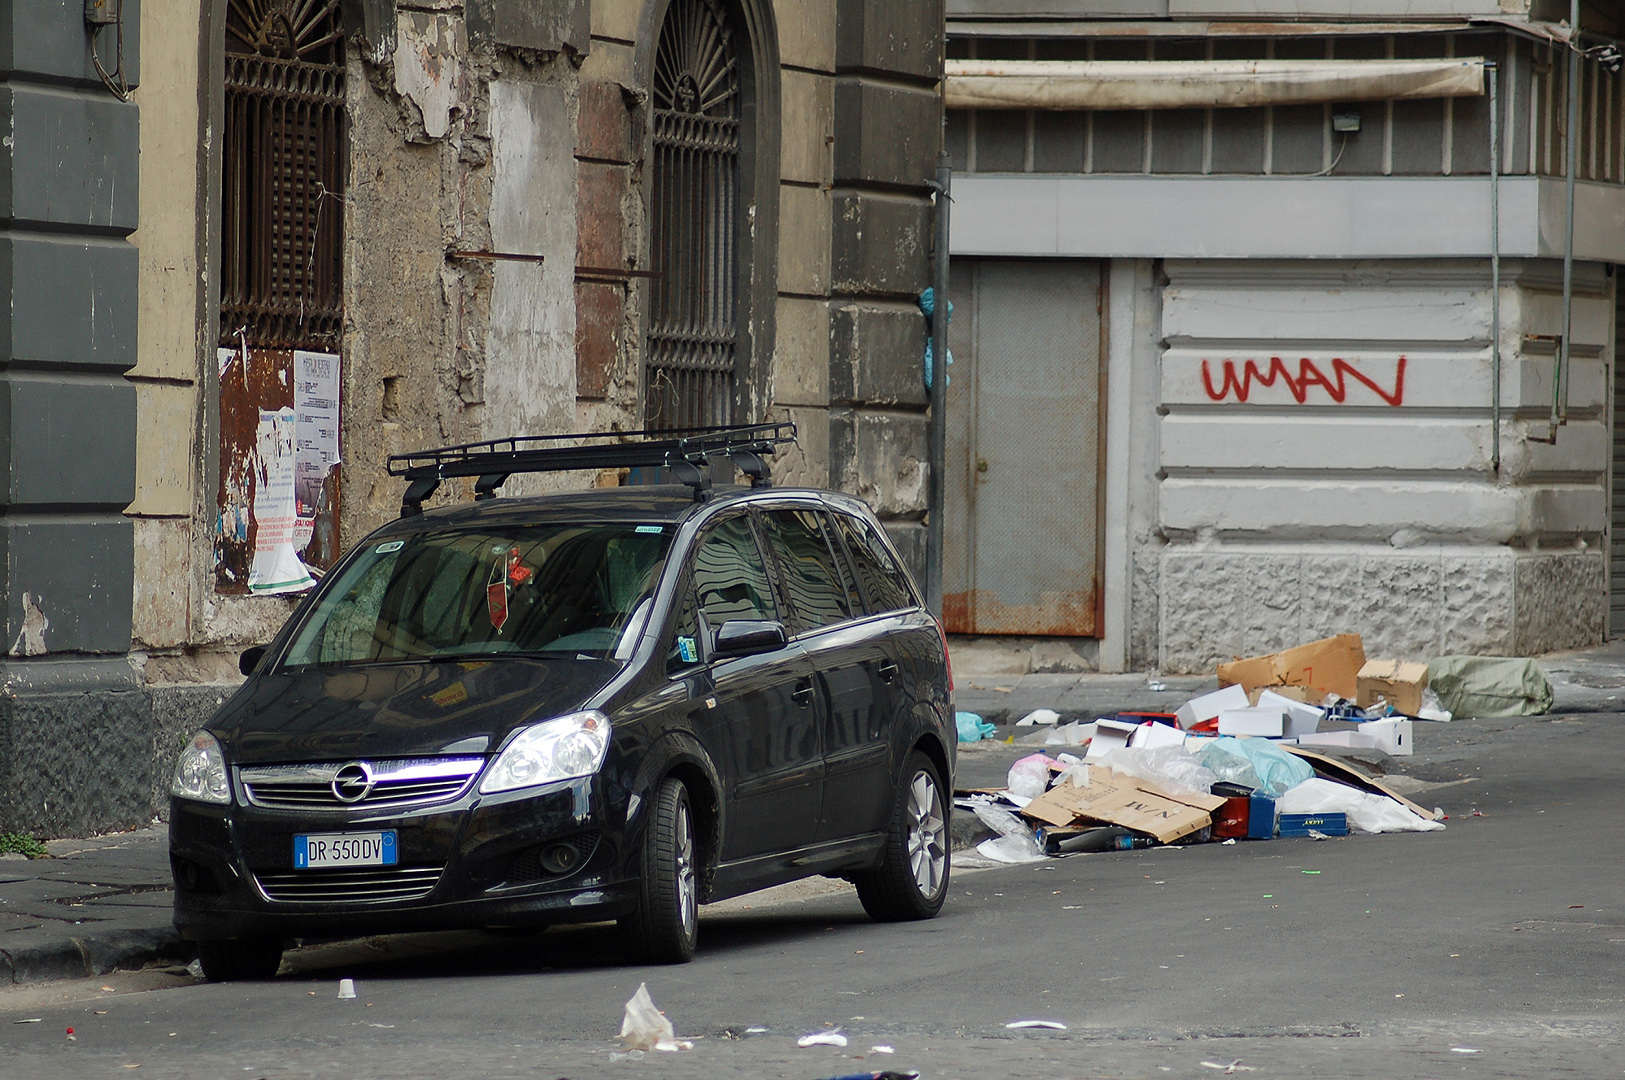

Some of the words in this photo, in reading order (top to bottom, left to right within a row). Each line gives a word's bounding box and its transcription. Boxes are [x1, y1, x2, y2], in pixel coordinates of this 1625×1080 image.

[1202, 355, 1406, 405] UMAN
[308, 841, 327, 861] DR
[332, 839, 381, 860] 550DV
